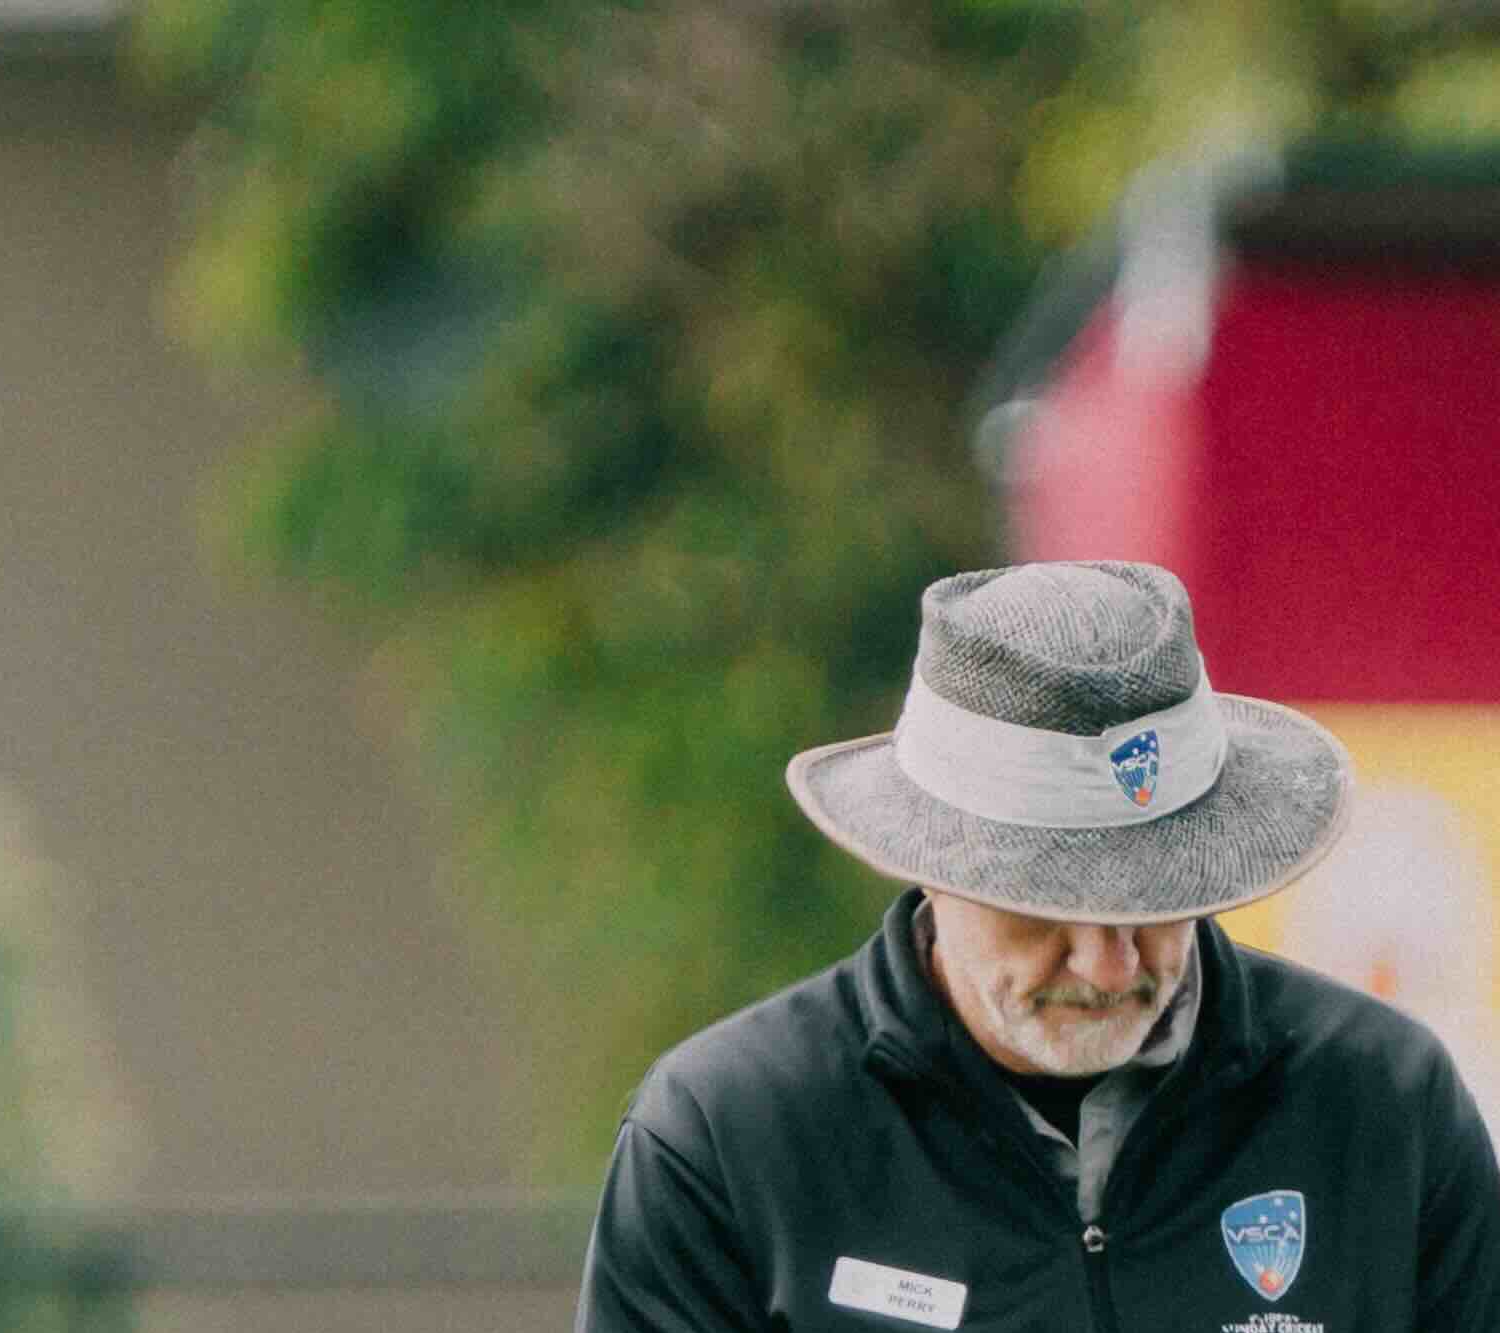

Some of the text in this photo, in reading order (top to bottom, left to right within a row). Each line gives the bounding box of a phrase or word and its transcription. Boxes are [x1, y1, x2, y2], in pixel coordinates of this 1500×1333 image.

[1226, 1222, 1301, 1244] VSCA
[898, 1279, 933, 1297] MICK
[887, 1294, 937, 1313] PERRY
